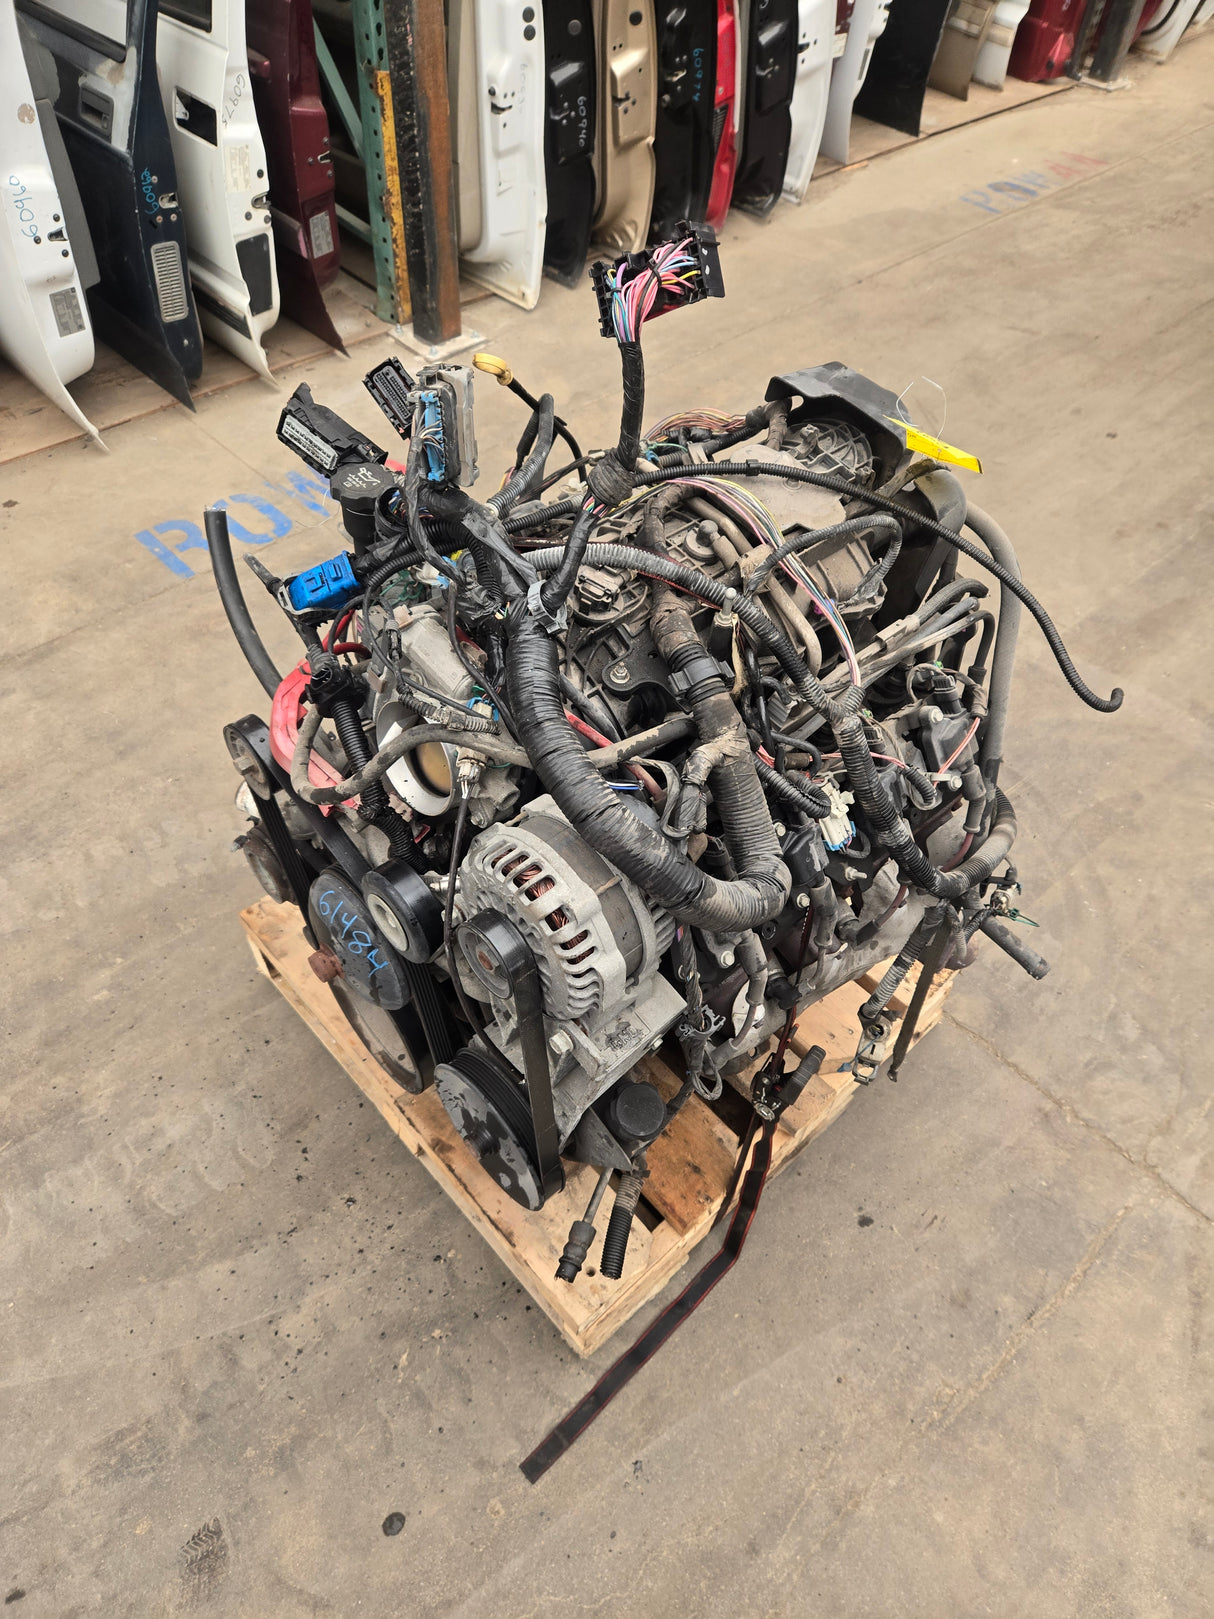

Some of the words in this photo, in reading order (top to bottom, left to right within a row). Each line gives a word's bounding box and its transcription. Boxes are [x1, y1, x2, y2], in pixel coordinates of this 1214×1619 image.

[221, 73, 246, 127] 60975
[577, 96, 587, 147] 60940
[9, 175, 38, 238] 60960
[319, 890, 390, 978] 61484
